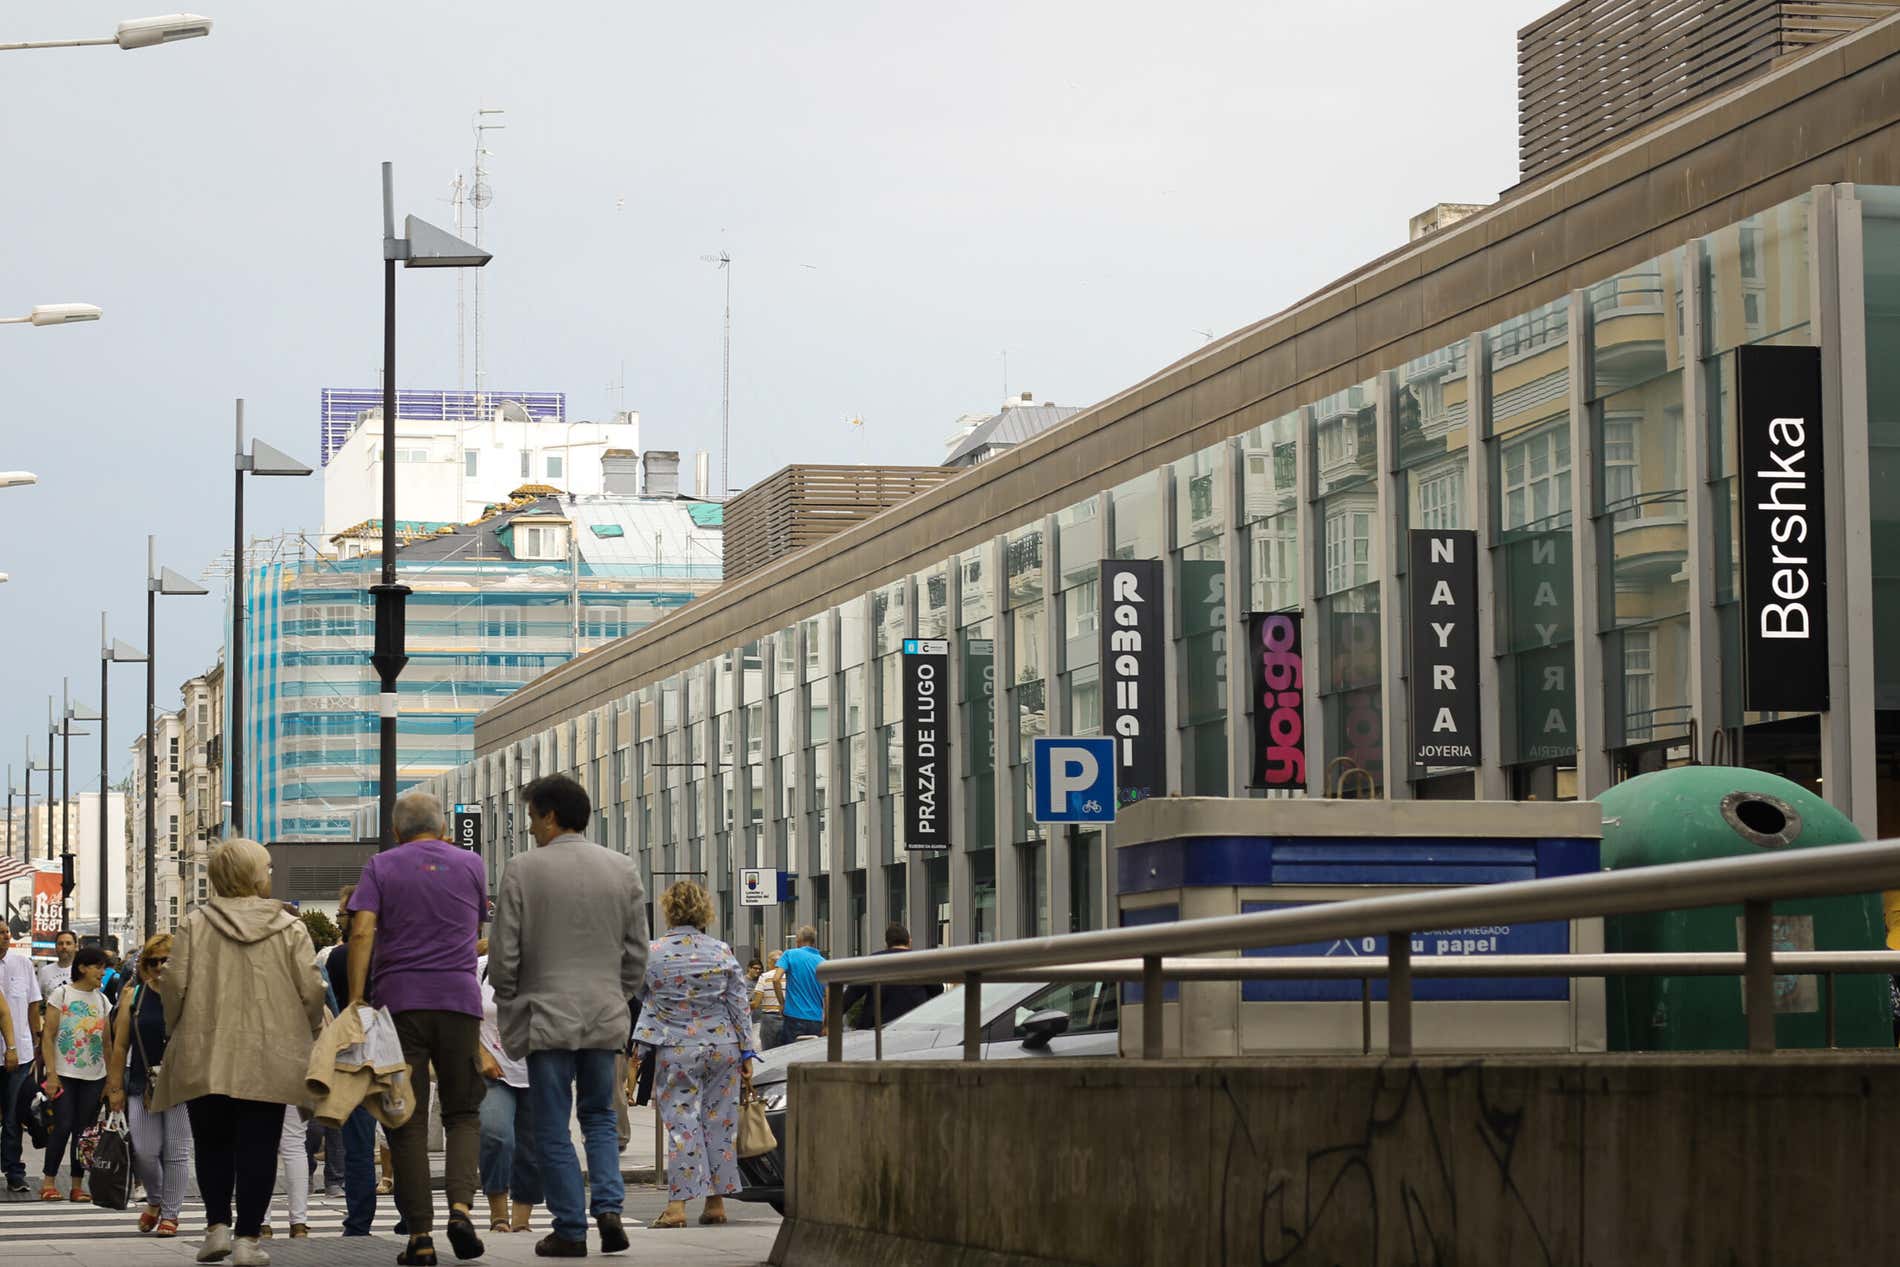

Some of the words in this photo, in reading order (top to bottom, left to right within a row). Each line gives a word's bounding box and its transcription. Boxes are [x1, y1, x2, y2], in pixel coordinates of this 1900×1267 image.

[1757, 417, 1810, 639] Bershka
[1430, 538, 1457, 732] NAYRA
[917, 664, 935, 723] LUGO
[1262, 615, 1305, 783] yoigo
[919, 729, 935, 757] DE
[1418, 745, 1472, 757] JOYERIA
[919, 763, 935, 833] PRAZA
[1049, 747, 1099, 813] P
[1437, 937, 1497, 955] papel
